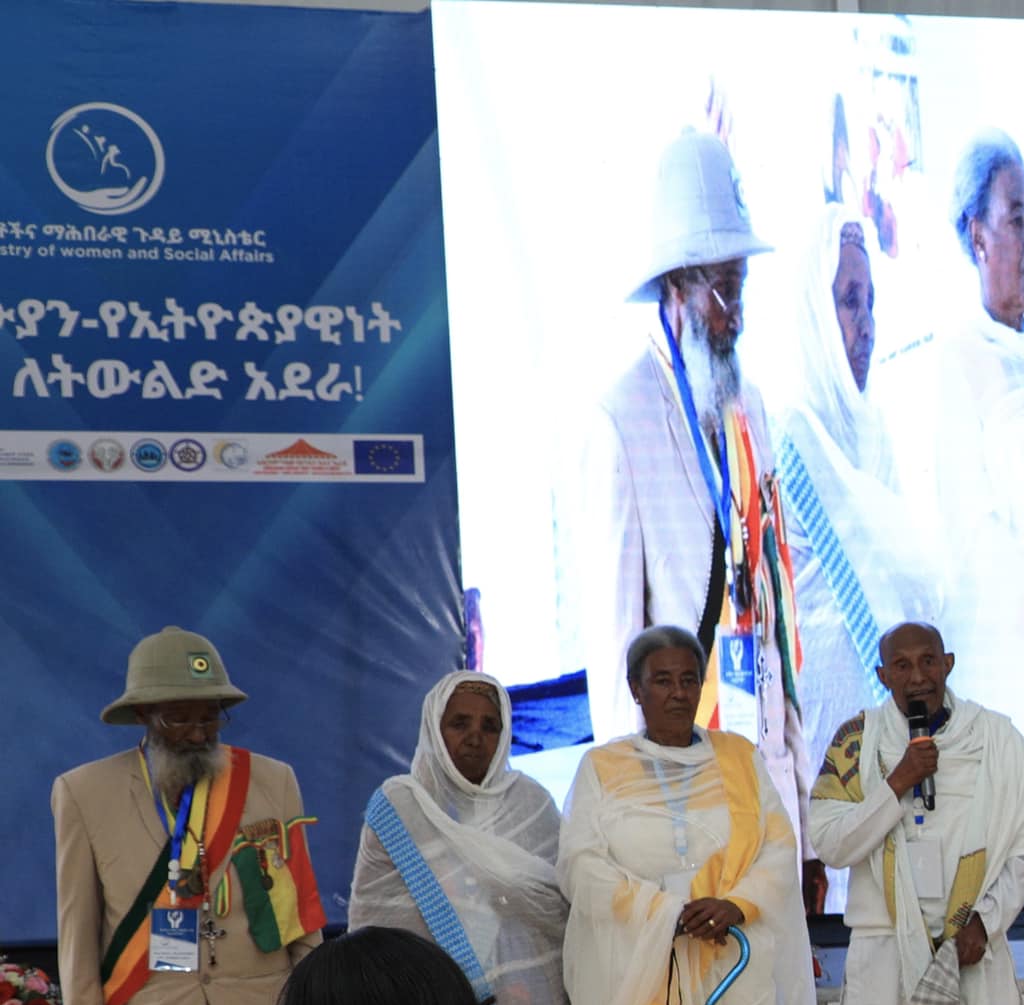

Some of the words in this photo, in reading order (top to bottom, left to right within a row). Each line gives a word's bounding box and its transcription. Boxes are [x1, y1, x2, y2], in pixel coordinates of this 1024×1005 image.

[37, 244, 55, 257] of
[60, 247, 122, 259] women
[127, 247, 159, 260] and
[163, 248, 215, 262] Social
[219, 248, 275, 264] Affairs
[13, 353, 229, 399] ለትውልድ
[244, 361, 363, 402] አደራ!
